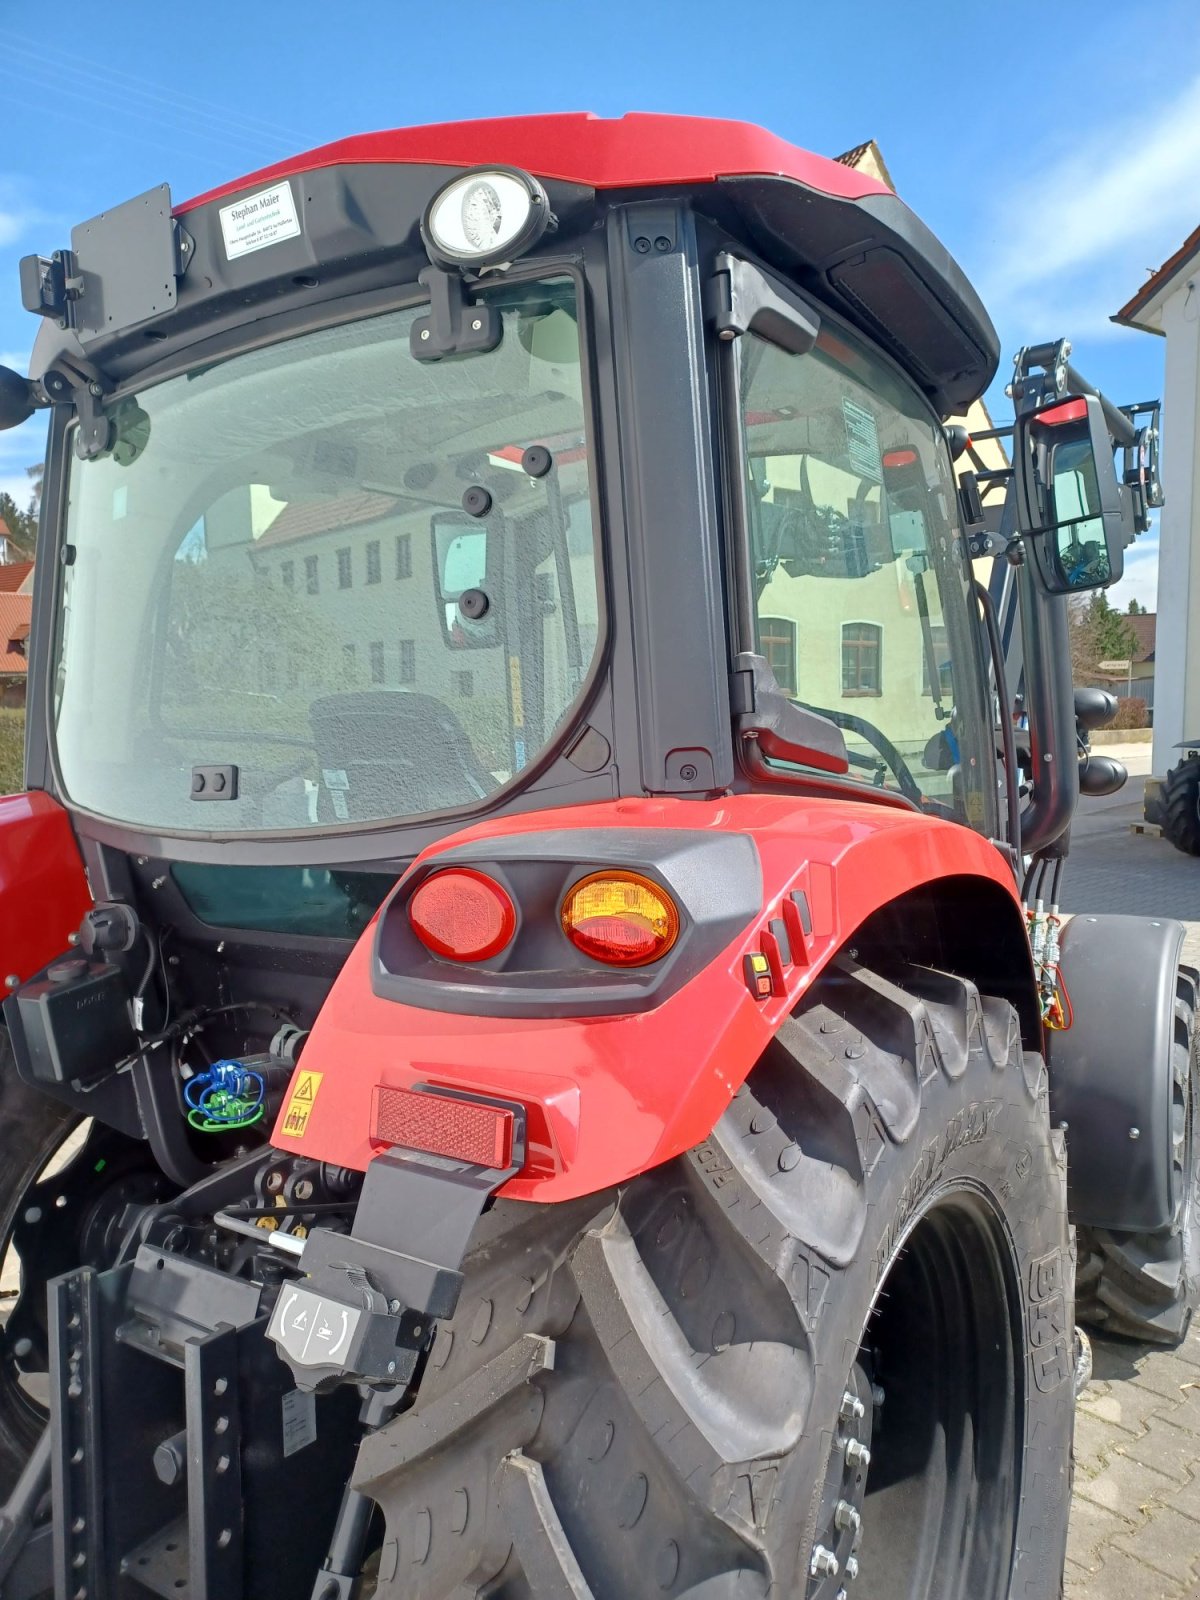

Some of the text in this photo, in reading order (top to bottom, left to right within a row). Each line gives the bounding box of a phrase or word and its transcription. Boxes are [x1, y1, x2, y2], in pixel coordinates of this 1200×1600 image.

[231, 195, 280, 221] Stephan Maier
[1028, 1247, 1071, 1393] BKT
